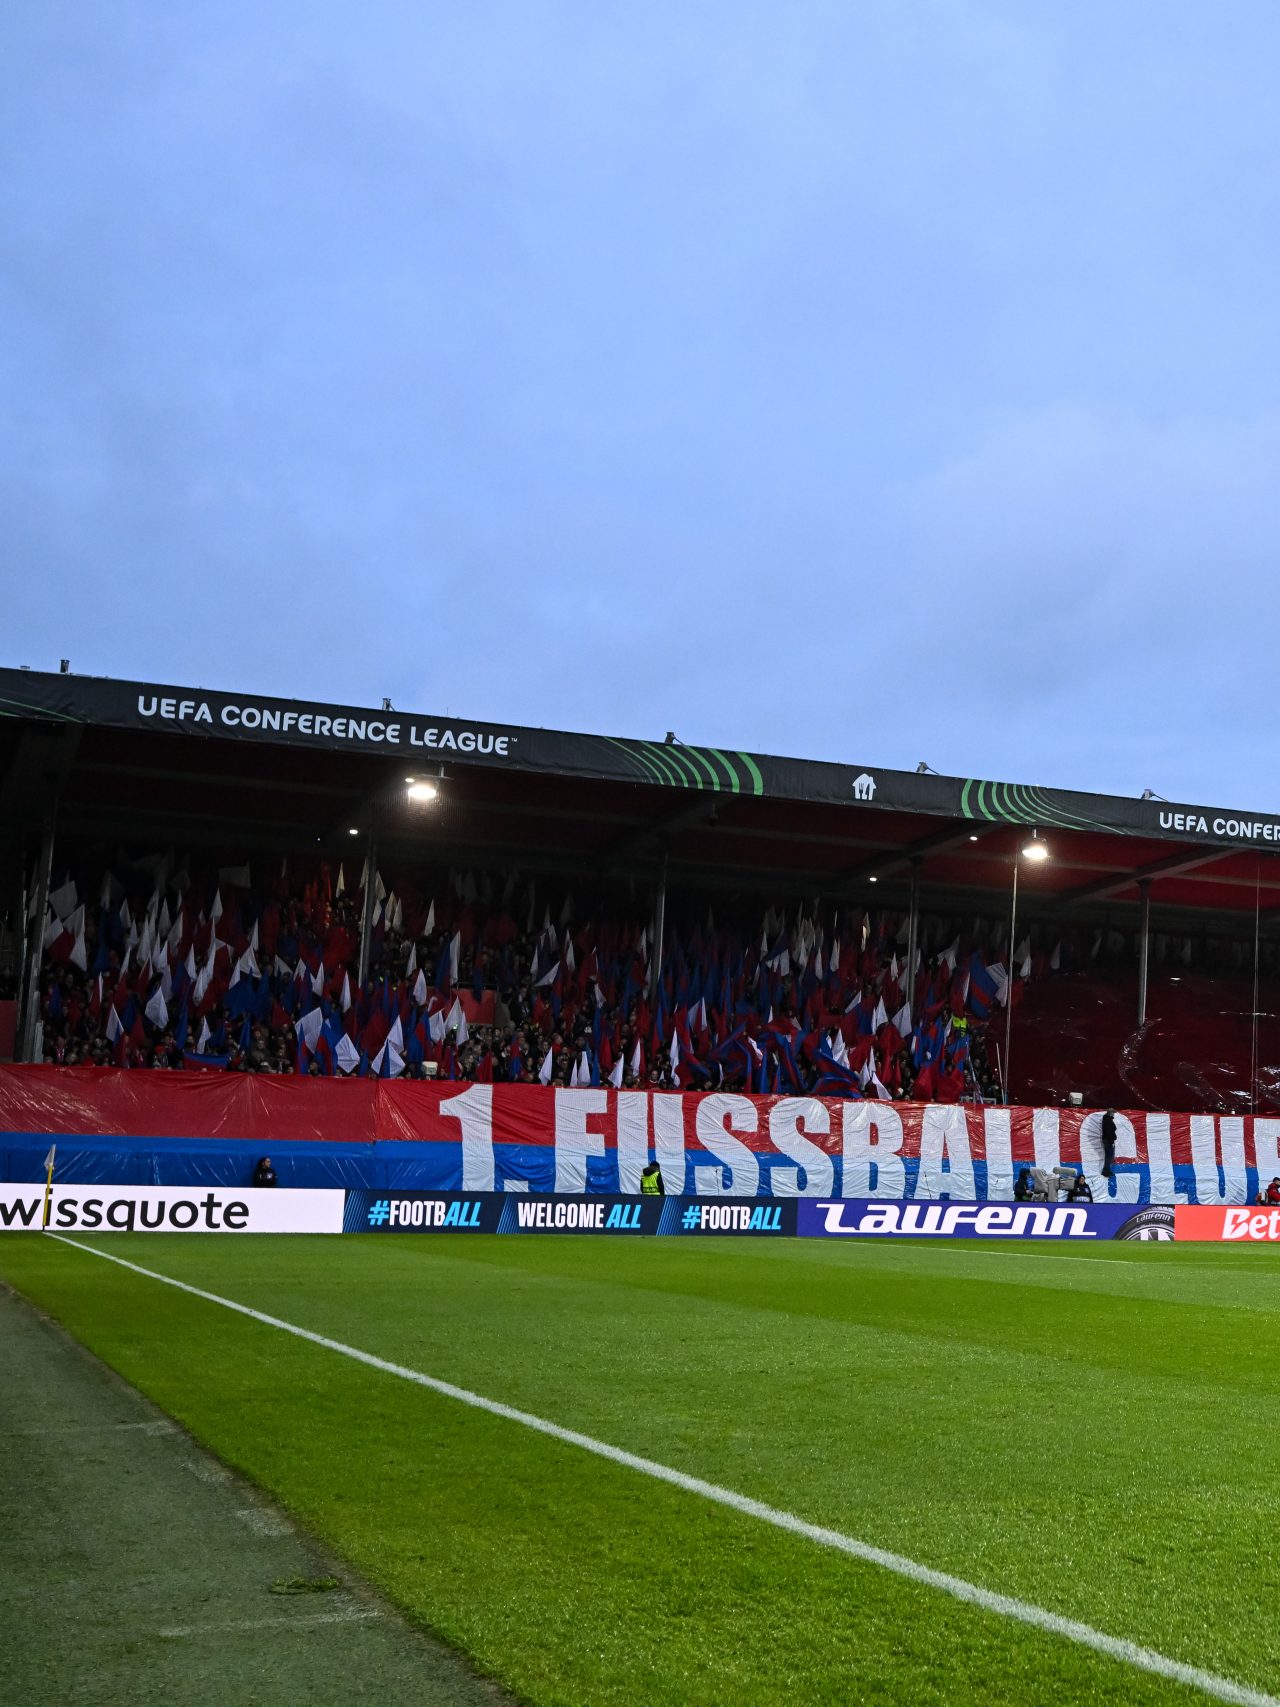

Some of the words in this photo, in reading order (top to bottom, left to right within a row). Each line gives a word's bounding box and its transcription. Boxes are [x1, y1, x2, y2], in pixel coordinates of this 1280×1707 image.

[138, 695, 213, 723] UEFA
[221, 705, 400, 744] CONFERENCE
[1159, 812, 1209, 834] UEFA
[439, 1083, 529, 1193] 1.
[367, 1200, 481, 1228] #FOOTBALL
[517, 1203, 604, 1228] WELCOME
[606, 1204, 642, 1229] ALL
[681, 1205, 782, 1230] #FOOTBALL
